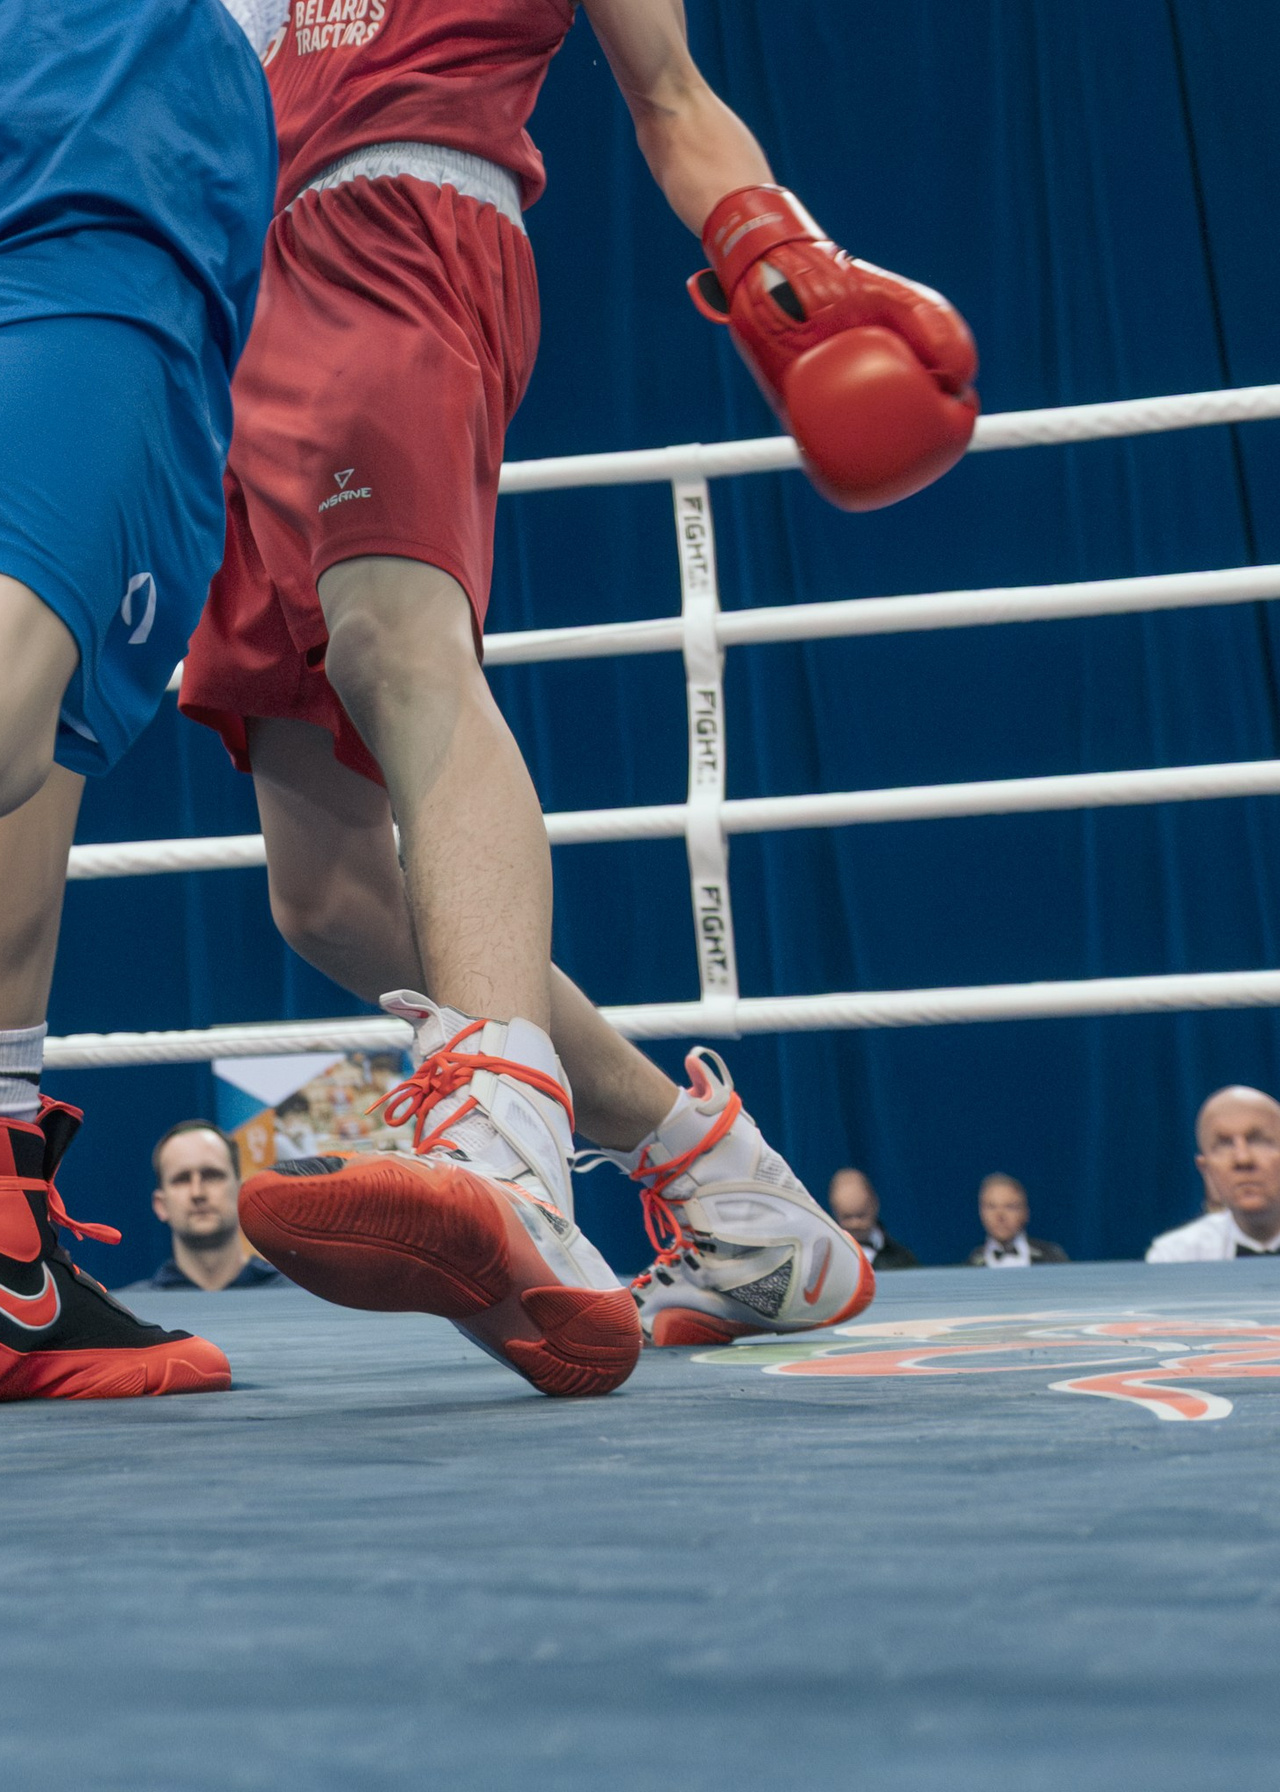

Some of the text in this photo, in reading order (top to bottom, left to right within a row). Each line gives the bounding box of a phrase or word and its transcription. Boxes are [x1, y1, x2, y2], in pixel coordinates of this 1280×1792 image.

[318, 487, 372, 513] INSANE
[683, 495, 707, 574] FIGHT
[696, 690, 718, 771] FIGHT
[701, 886, 728, 970] FIGHT
